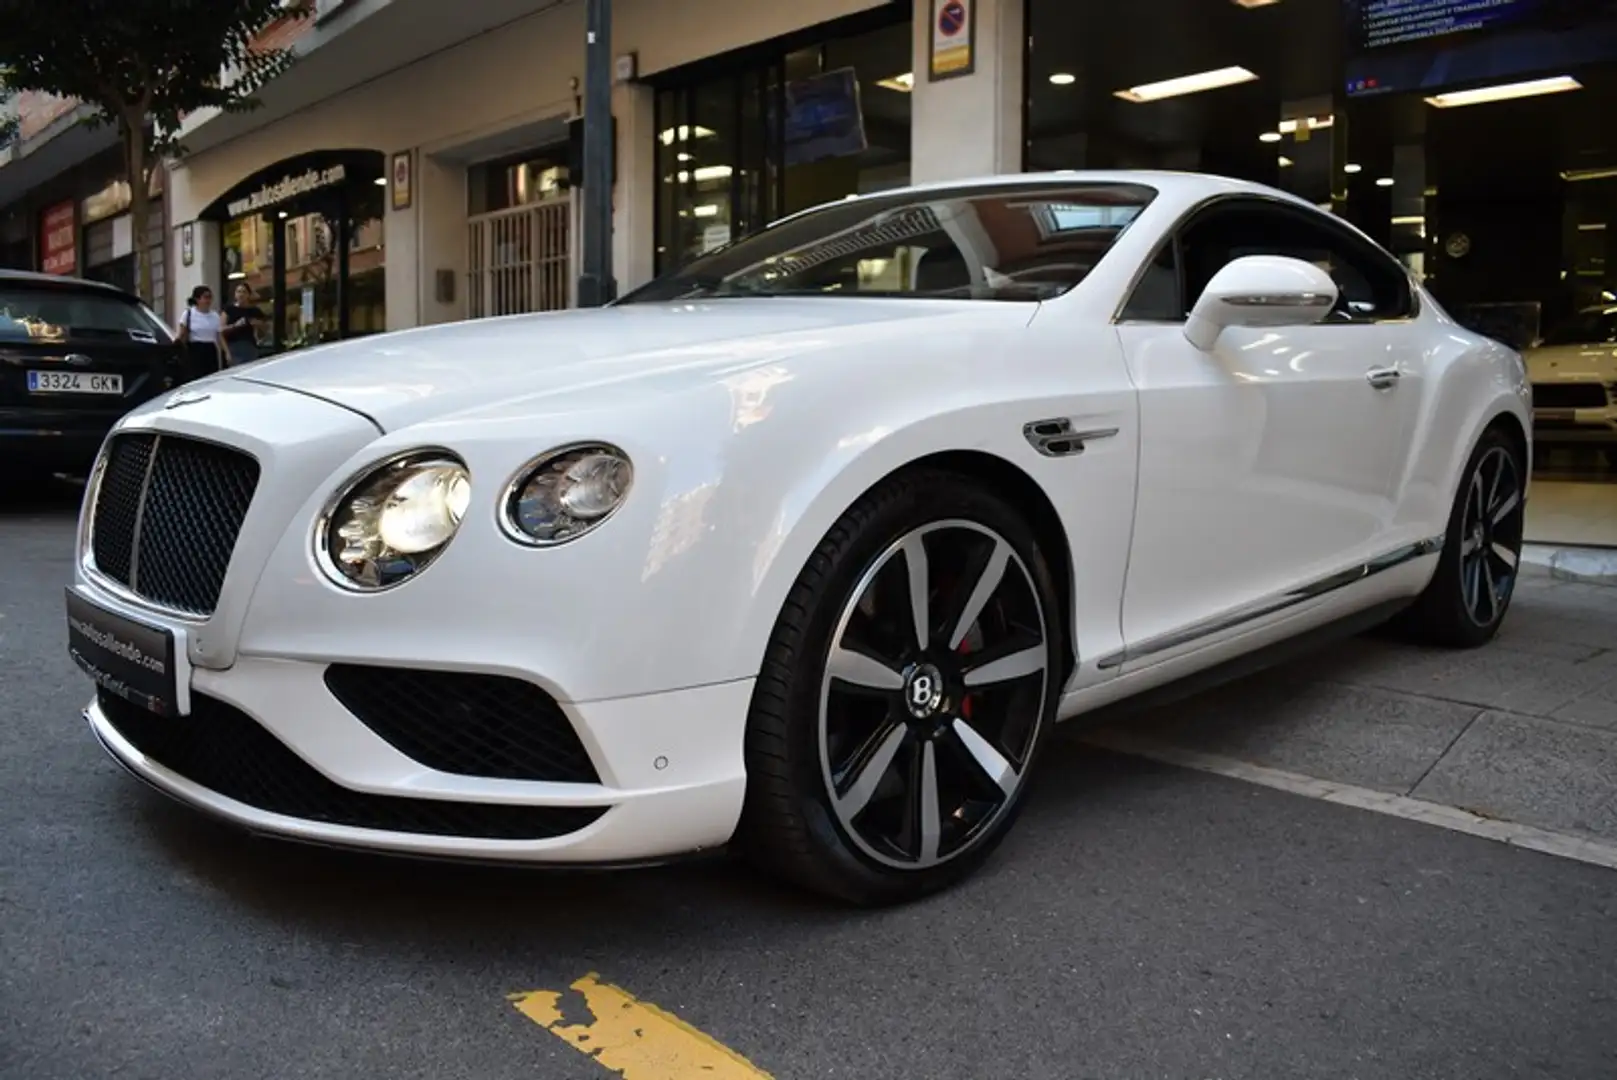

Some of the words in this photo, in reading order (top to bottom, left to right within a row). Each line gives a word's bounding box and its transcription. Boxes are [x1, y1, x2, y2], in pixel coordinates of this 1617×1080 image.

[40, 373, 81, 389] 3324
[91, 376, 120, 391] GKW
[913, 676, 931, 705] B
